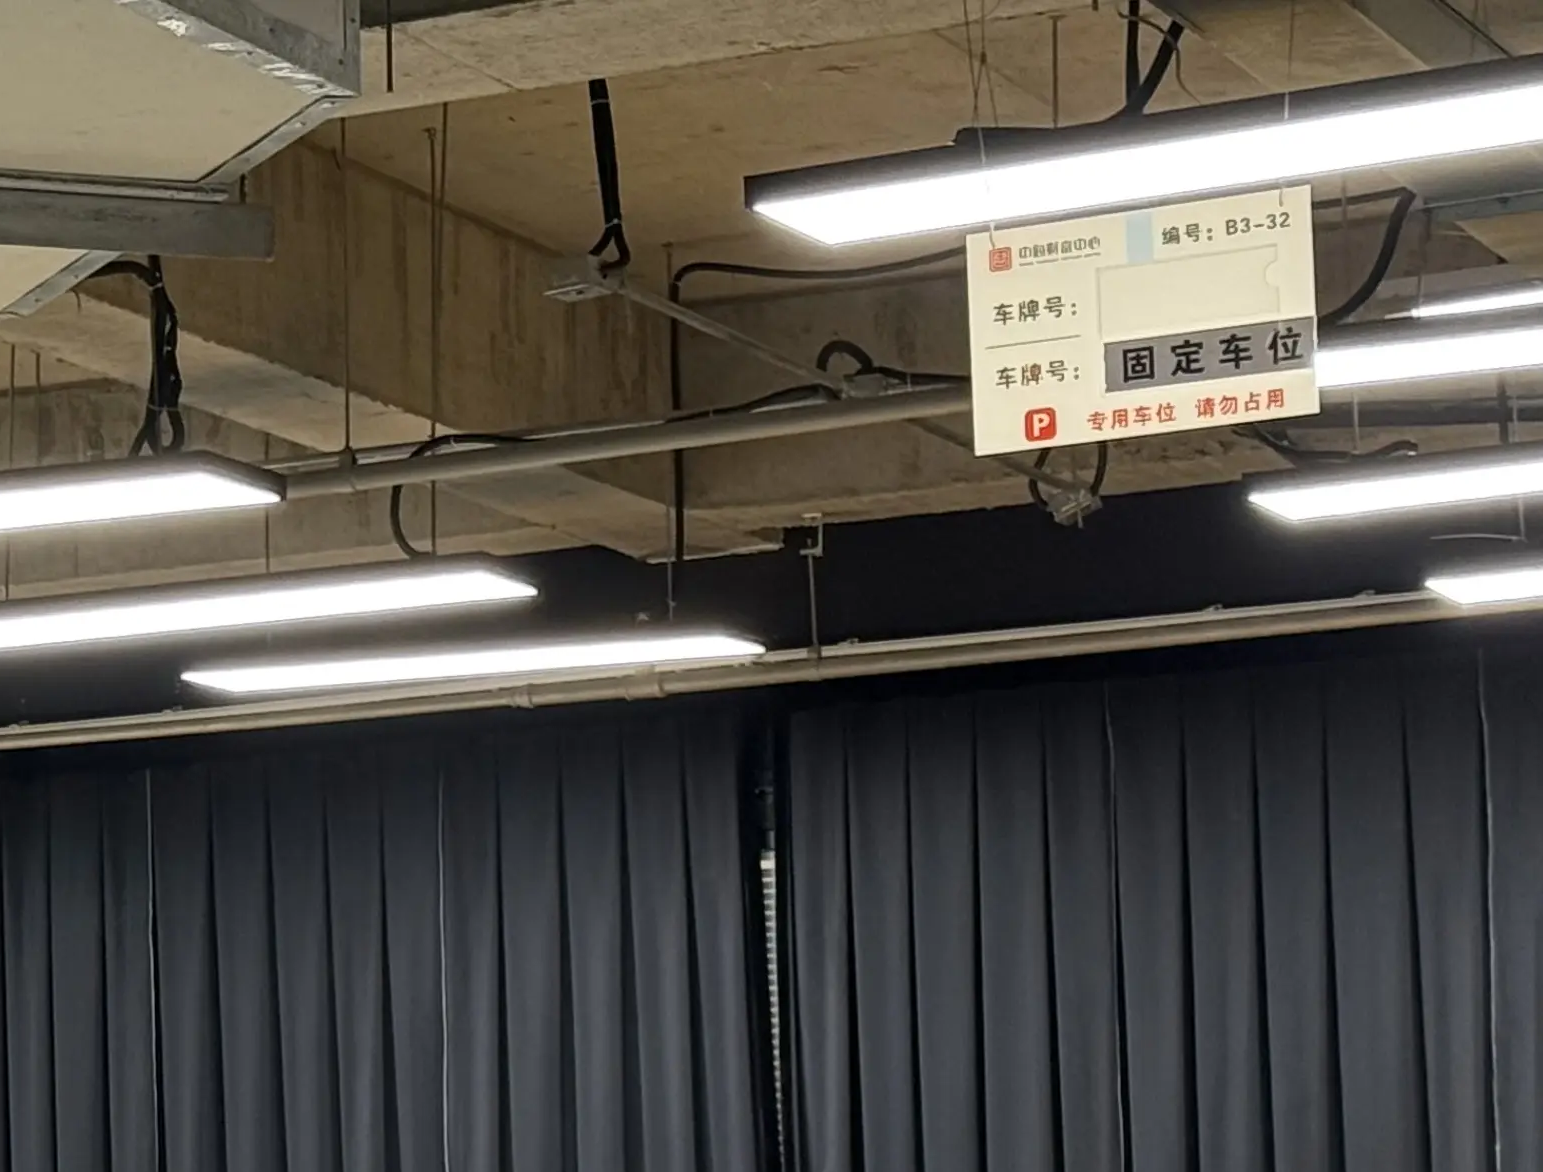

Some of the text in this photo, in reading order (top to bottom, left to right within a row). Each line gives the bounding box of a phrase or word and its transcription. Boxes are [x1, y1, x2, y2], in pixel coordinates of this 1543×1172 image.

[1225, 211, 1291, 236] B3-32
[993, 295, 1077, 326] 车牌号：
[1122, 326, 1304, 383] 固定车位
[1086, 388, 1286, 432] 专用车位 请勿占用
